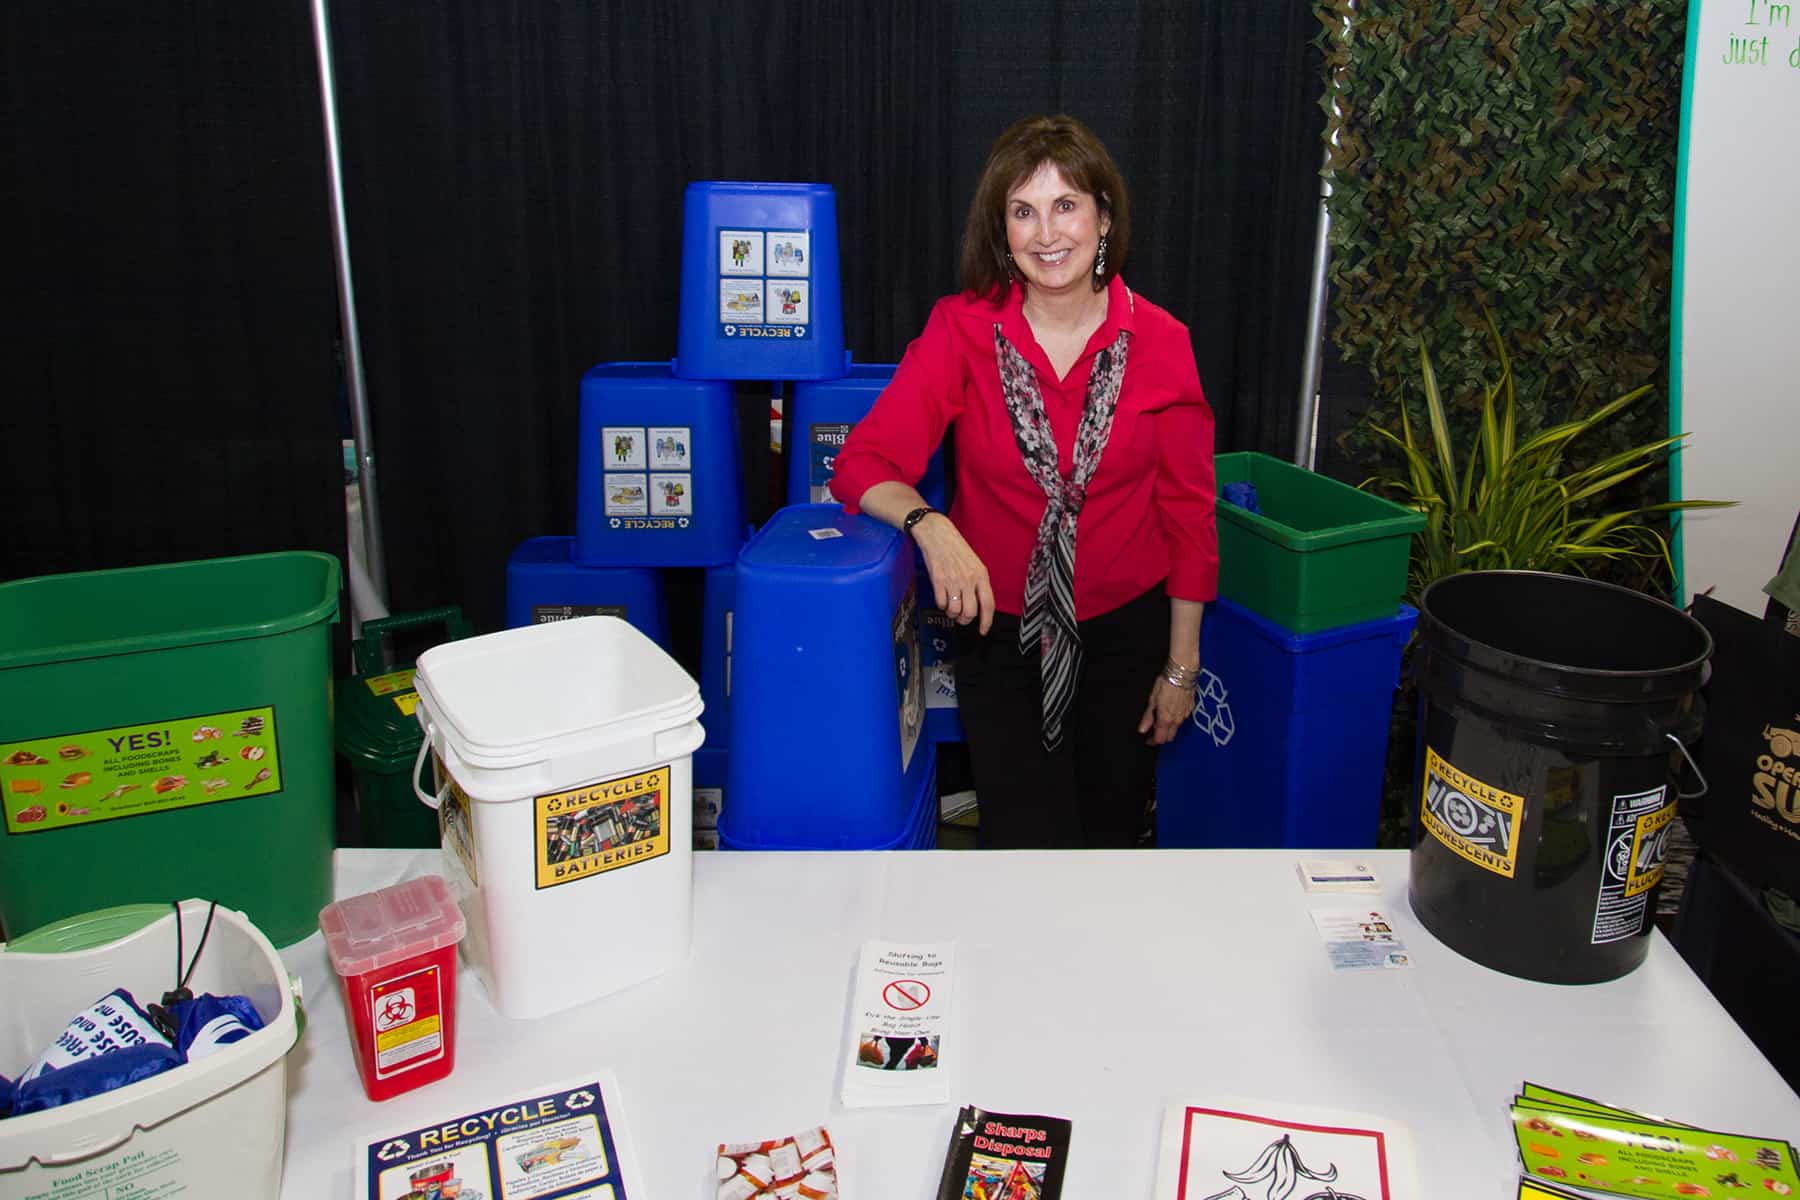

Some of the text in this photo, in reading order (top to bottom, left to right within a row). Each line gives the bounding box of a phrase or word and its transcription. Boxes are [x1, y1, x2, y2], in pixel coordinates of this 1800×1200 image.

[1744, 0, 1791, 28] I'm
[1722, 32, 1768, 65] just
[740, 327, 792, 337] RECYCLE
[817, 433, 845, 445] Blue
[624, 520, 675, 529] RECYCLE
[107, 730, 171, 753] YES!
[104, 756, 120, 765] ALL
[104, 760, 151, 772] INCLUDING
[566, 778, 644, 808] RECYCLE
[1439, 761, 1497, 802] RECYCLE
[554, 841, 656, 878] BATTERIES
[56, 1031, 88, 1056] FREE
[420, 1099, 557, 1150] RECYCLE
[984, 1121, 1047, 1143] Sharps
[973, 1136, 1053, 1159] Disposal
[52, 1173, 81, 1188] Food
[84, 1161, 119, 1177] Scrap
[122, 1151, 145, 1165] Pail
[115, 1182, 134, 1192] NO
